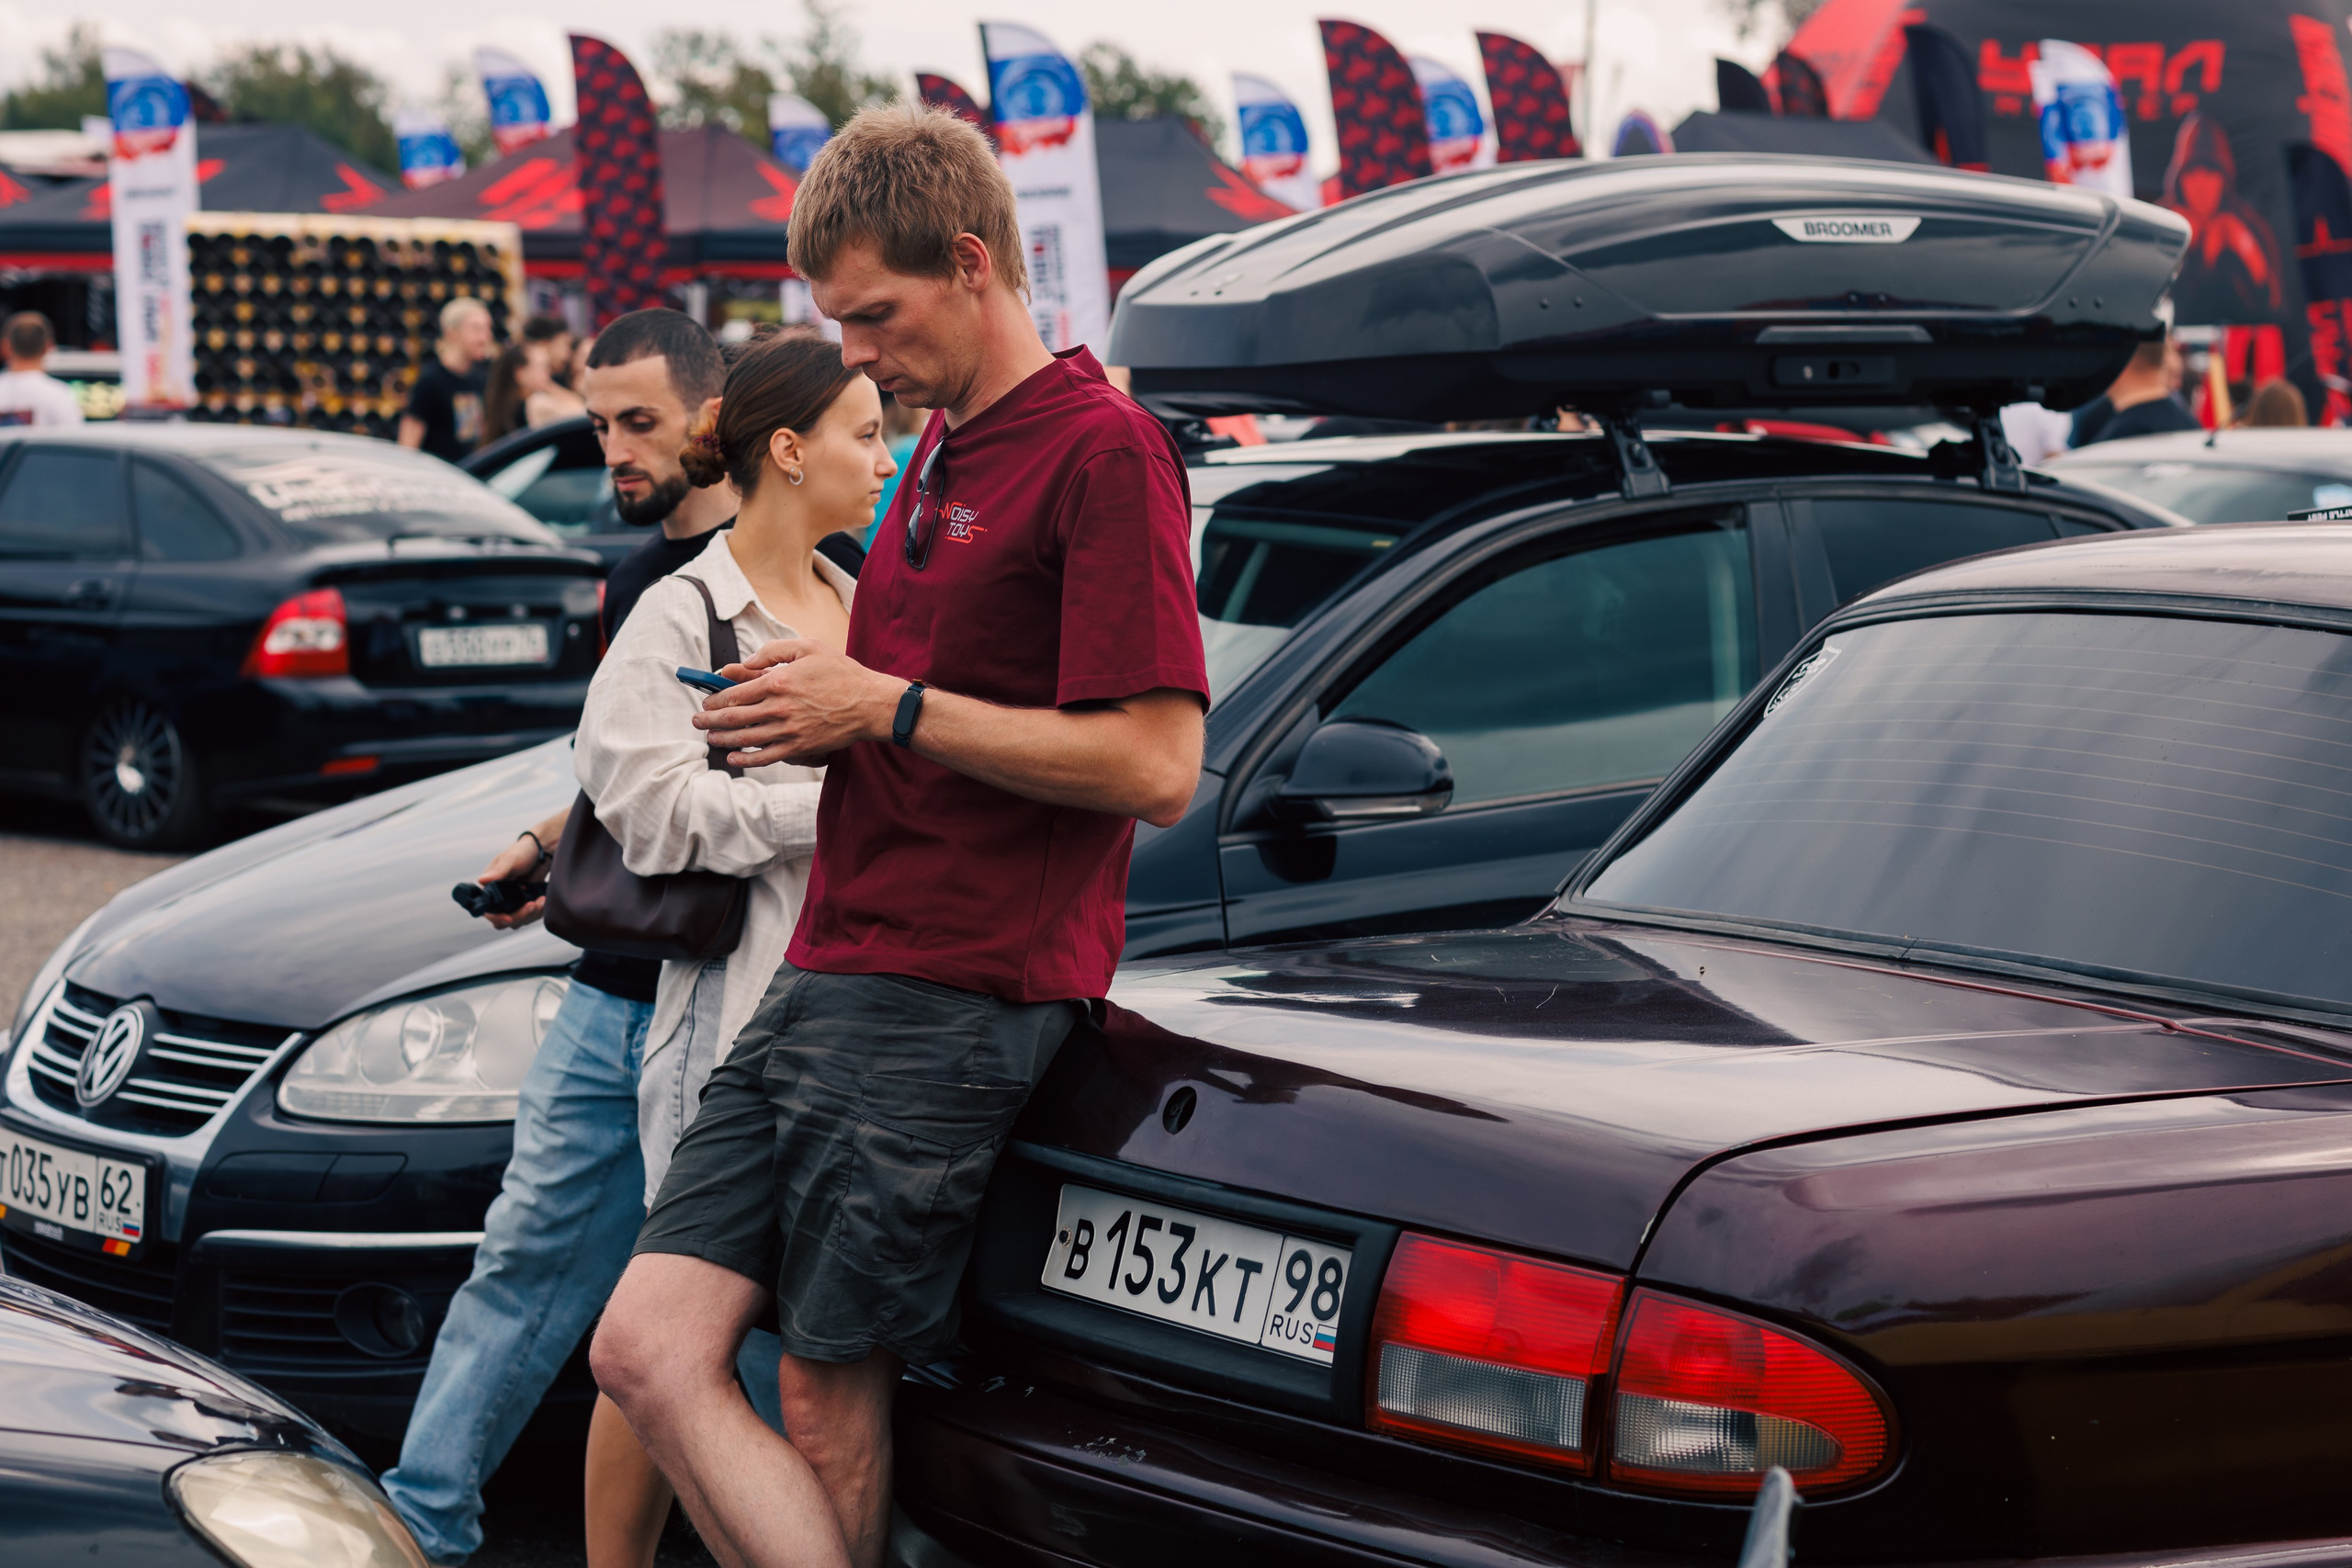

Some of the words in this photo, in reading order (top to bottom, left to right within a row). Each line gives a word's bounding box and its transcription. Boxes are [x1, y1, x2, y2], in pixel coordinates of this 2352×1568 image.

[1804, 221, 1892, 236] BROOMER
[937, 502, 979, 523] NOISY
[945, 523, 985, 544] TOYS
[101, 1167, 132, 1214] 62
[98, 1213, 122, 1232] RUS
[1284, 1249, 1344, 1321] 98
[1270, 1314, 1314, 1345] RUS
